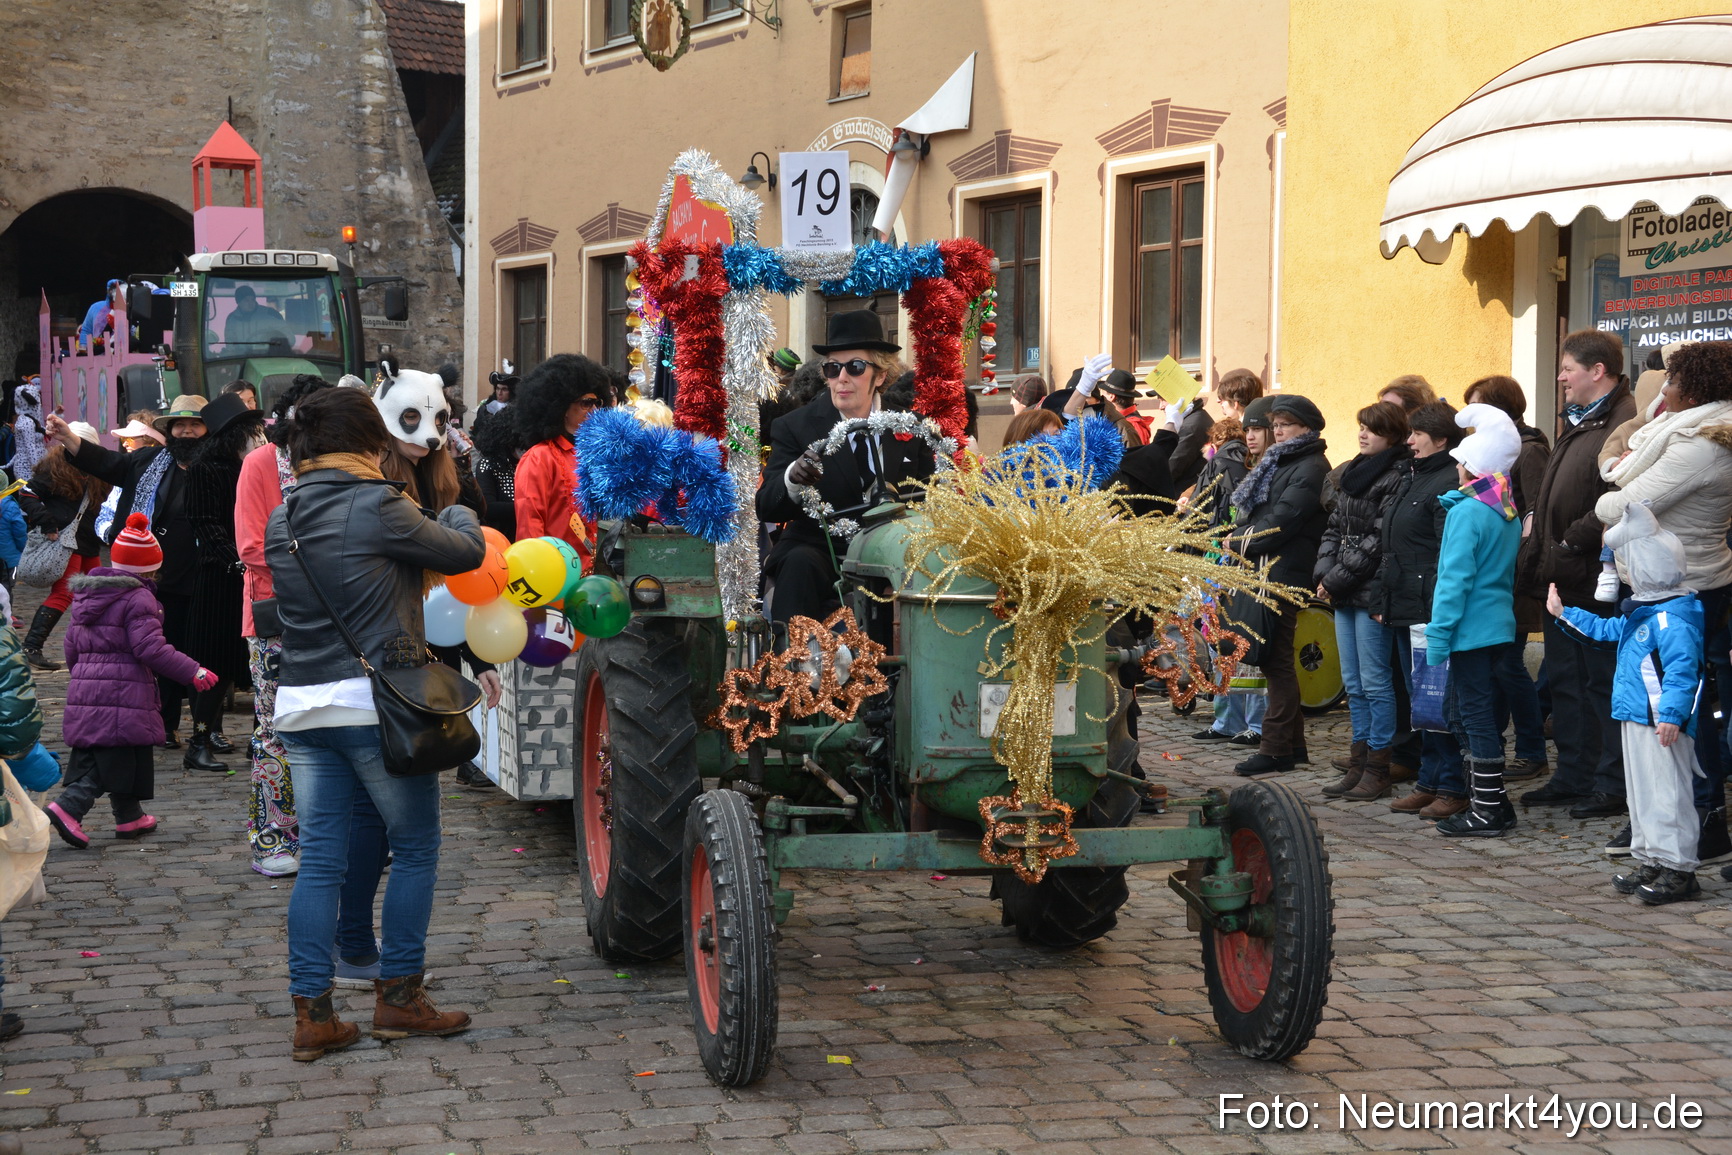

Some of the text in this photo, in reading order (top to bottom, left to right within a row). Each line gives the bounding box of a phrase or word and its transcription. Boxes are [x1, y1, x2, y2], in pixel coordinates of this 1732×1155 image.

[791, 168, 840, 216] 19
[1633, 272, 1700, 291] DIGITALE
[172, 289, 197, 297] SH 135
[1597, 315, 1660, 332] EINFACH
[1664, 312, 1687, 326] AM
[1638, 326, 1732, 347] AUSSUCHEN
[1029, 348, 1039, 360] 16
